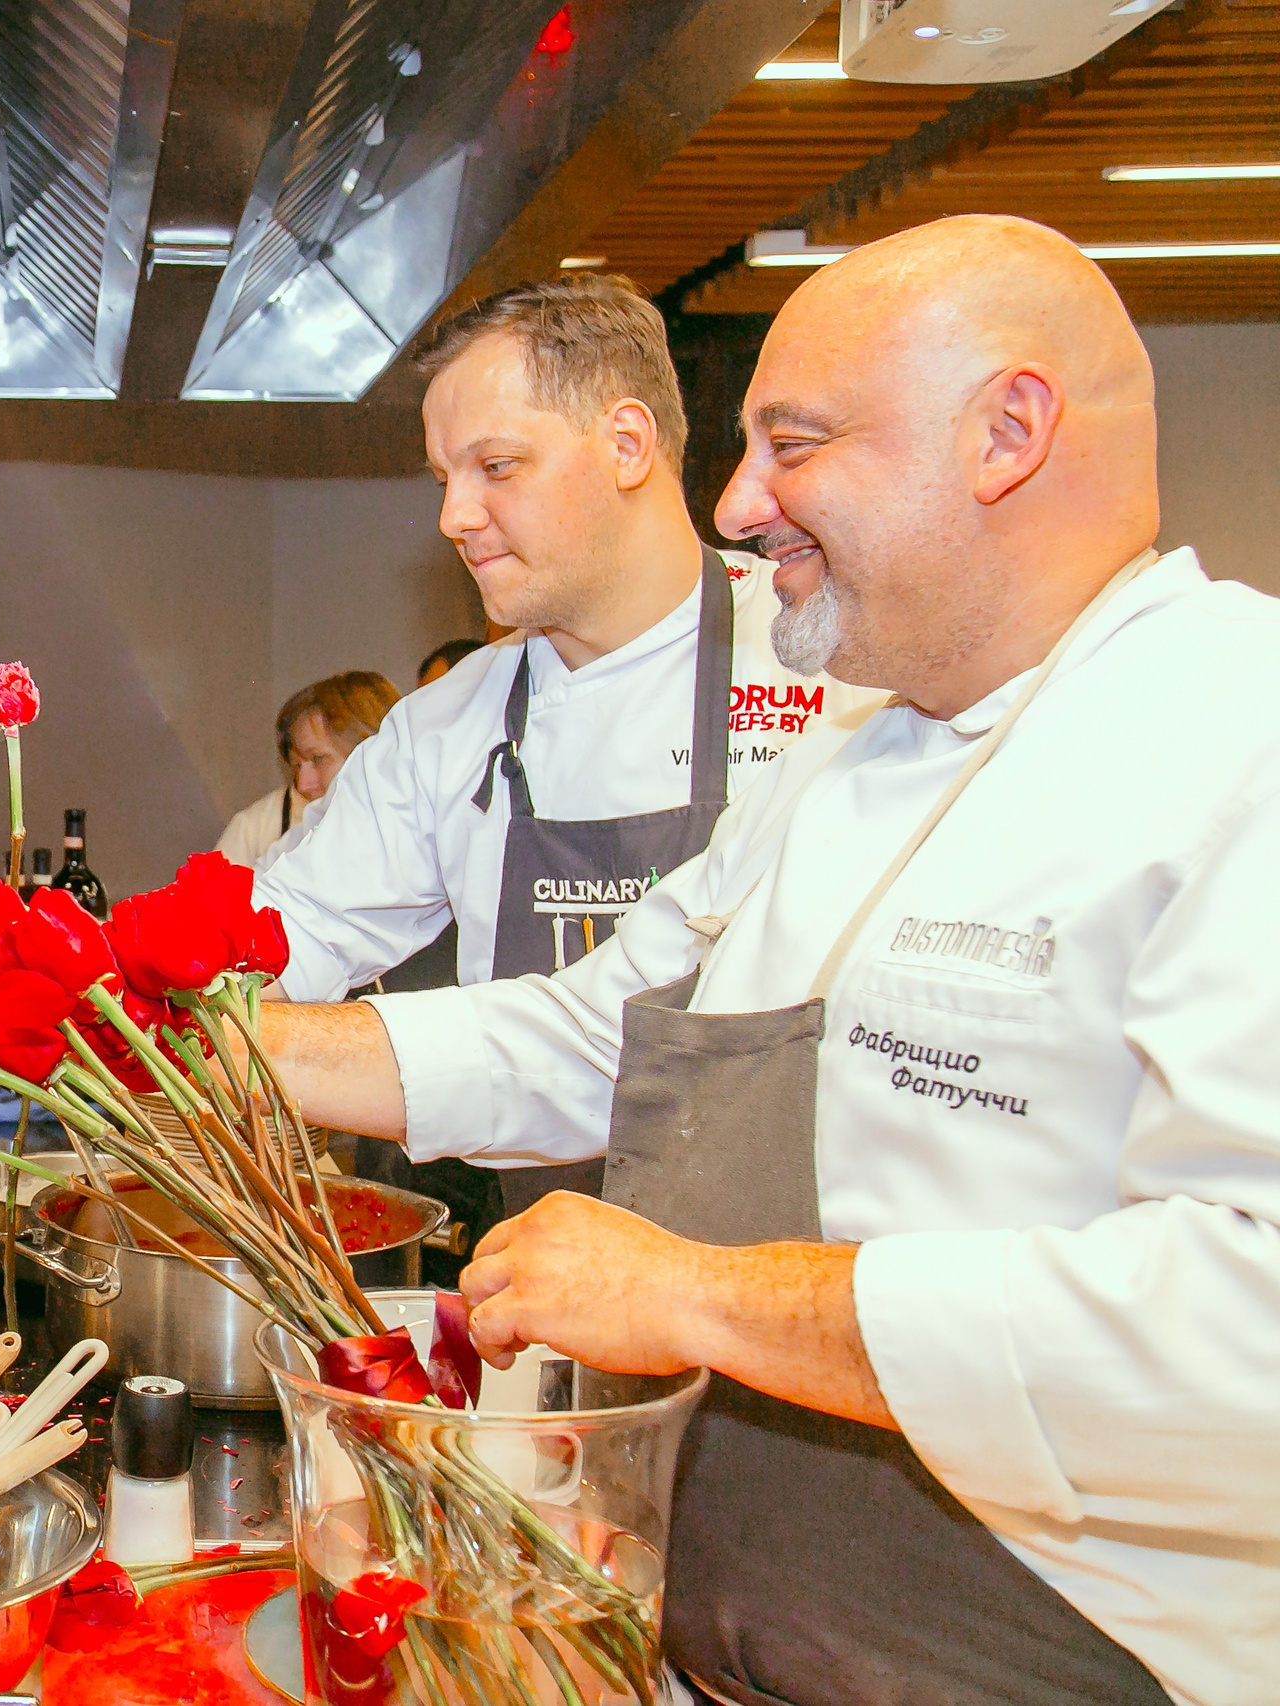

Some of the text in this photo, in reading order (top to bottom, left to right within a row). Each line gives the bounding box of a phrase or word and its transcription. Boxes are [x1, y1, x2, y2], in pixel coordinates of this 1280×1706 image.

[729, 684, 825, 715] ORUM
[848, 1022, 982, 1074] Фабрицио
[891, 1065, 1028, 1117] Фатуччи
